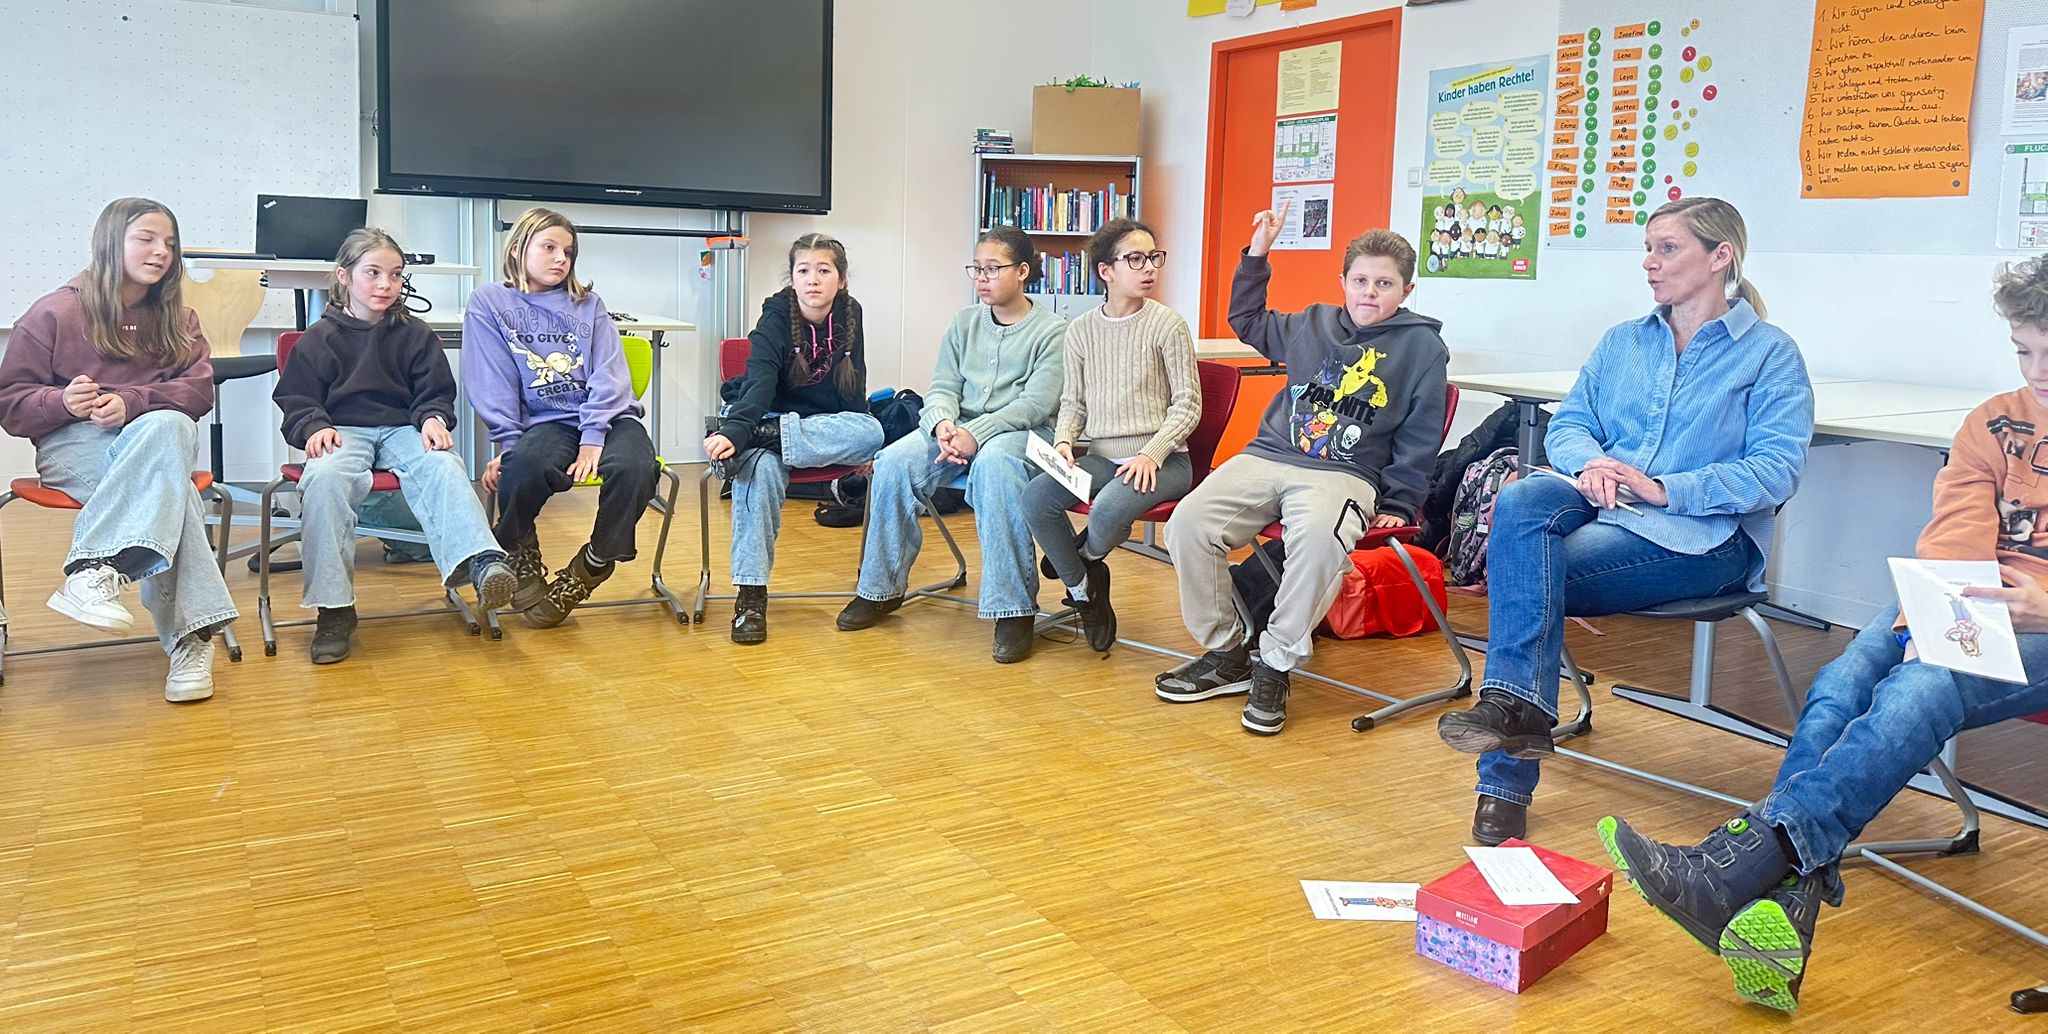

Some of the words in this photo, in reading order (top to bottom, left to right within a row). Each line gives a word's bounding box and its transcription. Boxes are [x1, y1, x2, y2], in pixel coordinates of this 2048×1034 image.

[1832, 7, 1847, 20] Wir
[1850, 5, 1882, 20] ärgern
[1830, 37, 1844, 50] Wir
[1848, 36, 1875, 46] hören
[1878, 31, 1896, 42] den
[1900, 28, 1940, 40] anderen
[1438, 88, 1465, 102] Kinder
[1468, 80, 1496, 96] haben
[1499, 69, 1534, 88] Rechte!
[1300, 382, 1376, 425] FORNITE
